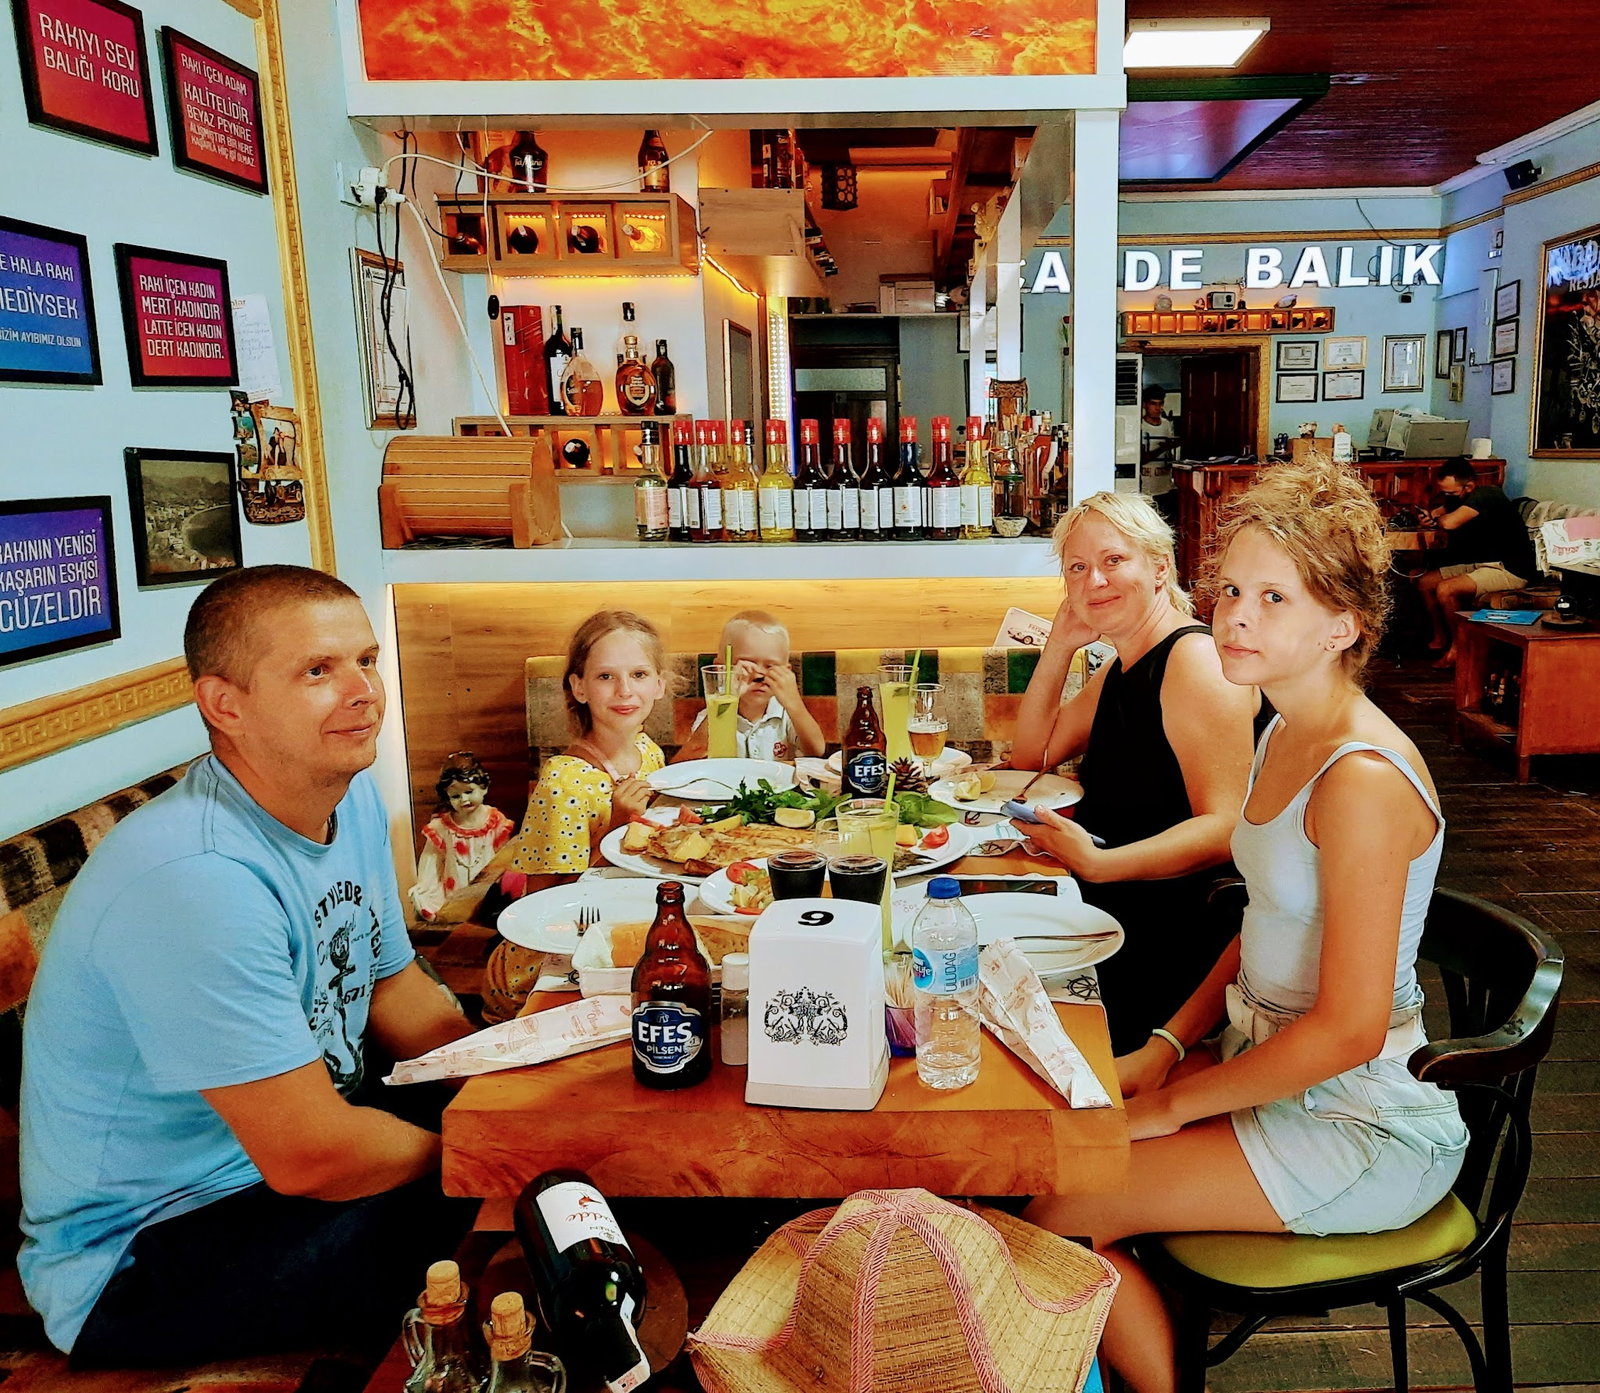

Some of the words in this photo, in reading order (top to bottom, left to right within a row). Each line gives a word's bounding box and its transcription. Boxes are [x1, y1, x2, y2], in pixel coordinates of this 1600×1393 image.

[39, 12, 101, 58] RAKIYI
[104, 39, 134, 71] SEV
[43, 46, 94, 82] BALIĞI
[101, 67, 139, 98] KORU
[180, 53, 201, 74] RAKI
[202, 61, 223, 83] İÇEN
[224, 75, 247, 96] ADAM
[186, 104, 215, 128] BEYAZ
[9, 255, 44, 277] HALA
[45, 262, 74, 282] RAKI
[1245, 244, 1444, 290] BALIK
[139, 274, 164, 293] RAKI
[164, 274, 187, 299] İÇEN
[188, 281, 216, 299] KADIN
[141, 296, 172, 316] MERT
[144, 319, 174, 336] LATTE
[196, 323, 223, 339] KADIN
[57, 335, 82, 348] OLSUN
[146, 339, 174, 356] DERT
[176, 341, 225, 359] KADINDIR.
[54, 528, 97, 558] YENİSİ
[59, 555, 98, 584] ESKİSİ
[854, 763, 884, 777] EFES
[797, 910, 835, 926] 9
[942, 952, 958, 992] ULUDAĞ
[638, 1020, 693, 1043] EFES
[646, 1044, 682, 1055] PİLSEN
